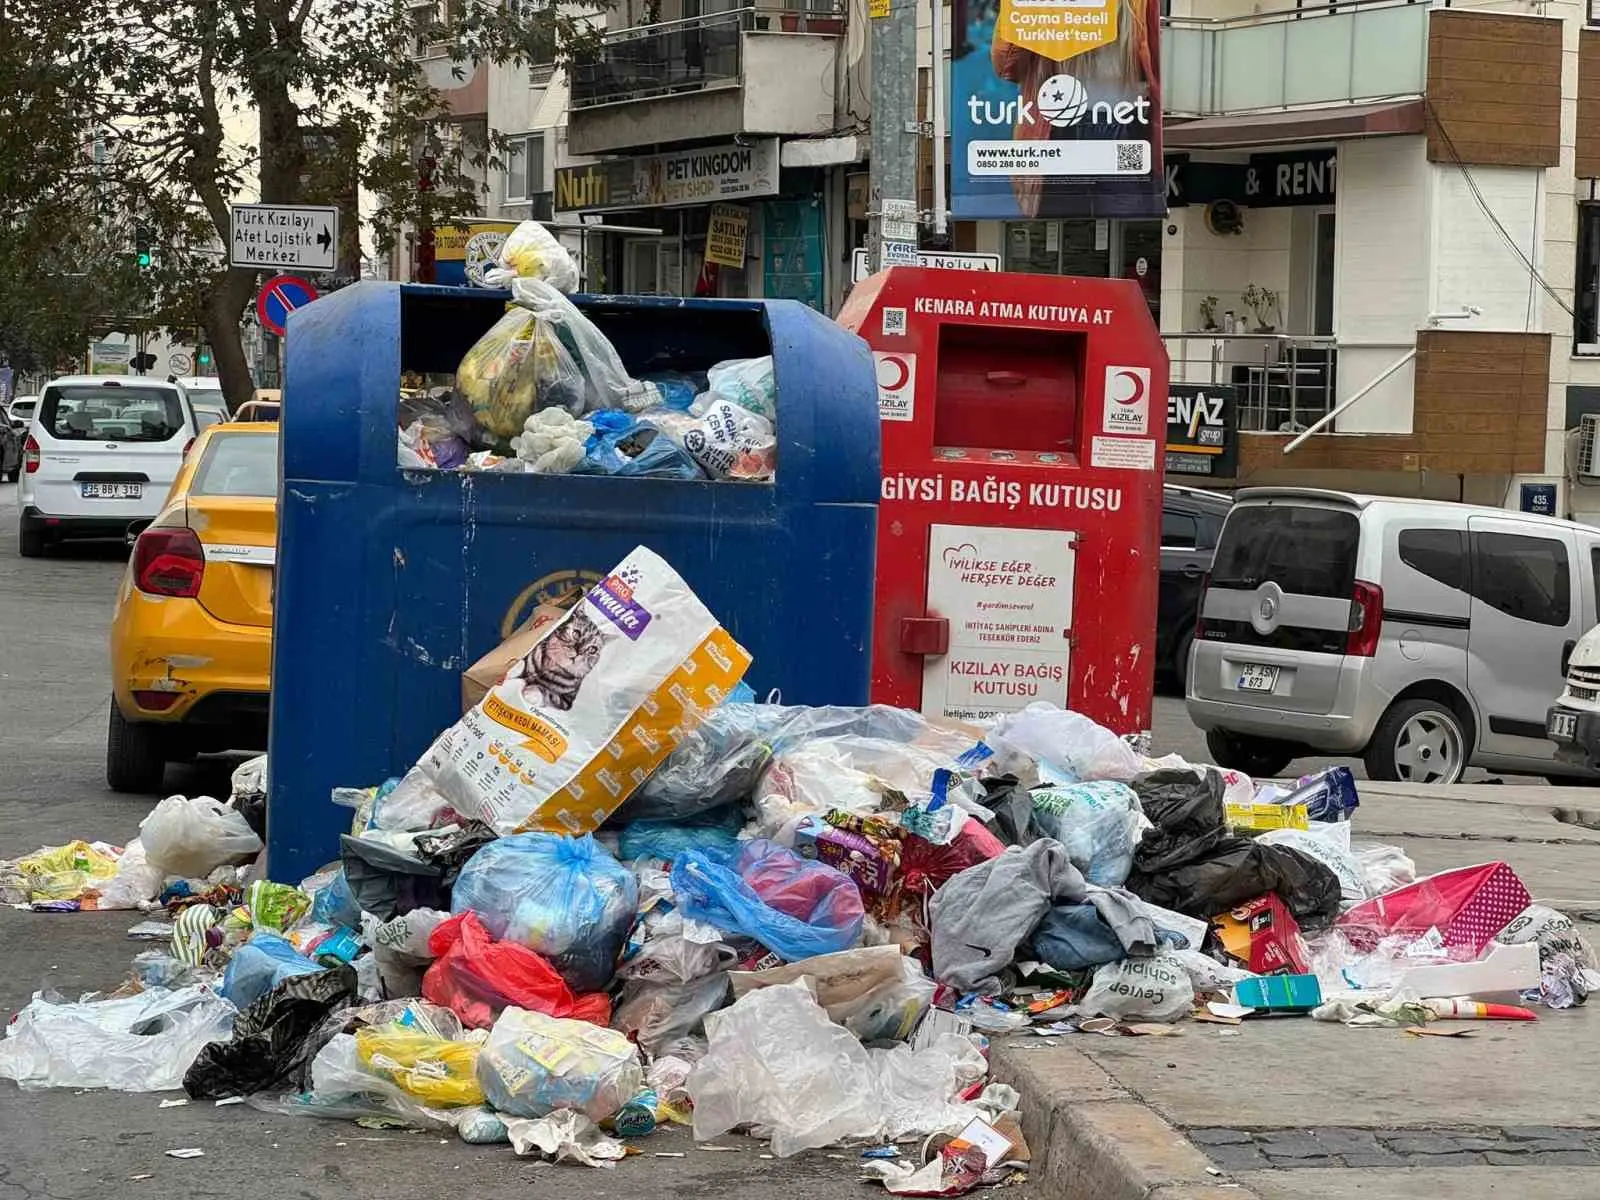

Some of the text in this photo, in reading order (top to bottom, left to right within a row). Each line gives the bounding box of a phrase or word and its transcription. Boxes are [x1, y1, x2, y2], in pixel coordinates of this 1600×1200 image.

[1010, 12, 1108, 26] Cayma Bedeli
[1016, 28, 1102, 41] TurkNet'ten!
[968, 95, 1151, 125] turk net
[976, 147, 1061, 158] www.turk.net
[666, 150, 752, 180] PET KINGDOM
[976, 160, 1040, 168] 0850 288 80 80
[1245, 168, 1260, 195] &
[666, 182, 685, 200] PET
[687, 180, 715, 197] SHOP
[235, 210, 314, 230] Türk Kızılayı
[235, 228, 312, 249] Afet Lojistik
[246, 246, 300, 262] Merkezi
[919, 257, 928, 267] 3
[914, 297, 1113, 324] KENARA ATMA KUTUYA AT
[1110, 413, 1143, 421] KIZILAY
[1200, 430, 1221, 442] grup
[881, 472, 1121, 511] GİYSİ BAĞIŞ KUTUSU
[949, 557, 1032, 573] İYİLİKSE EĞER
[961, 573, 1056, 588] HERŞEYE DEĞER
[965, 621, 993, 634] İHTİYAÇ
[1033, 625, 1055, 633] ADINA
[1016, 634, 1041, 643] EDERİZ
[951, 661, 1063, 682] KIZILAY BAĞIŞ
[974, 681, 1038, 696] KUTUSU
